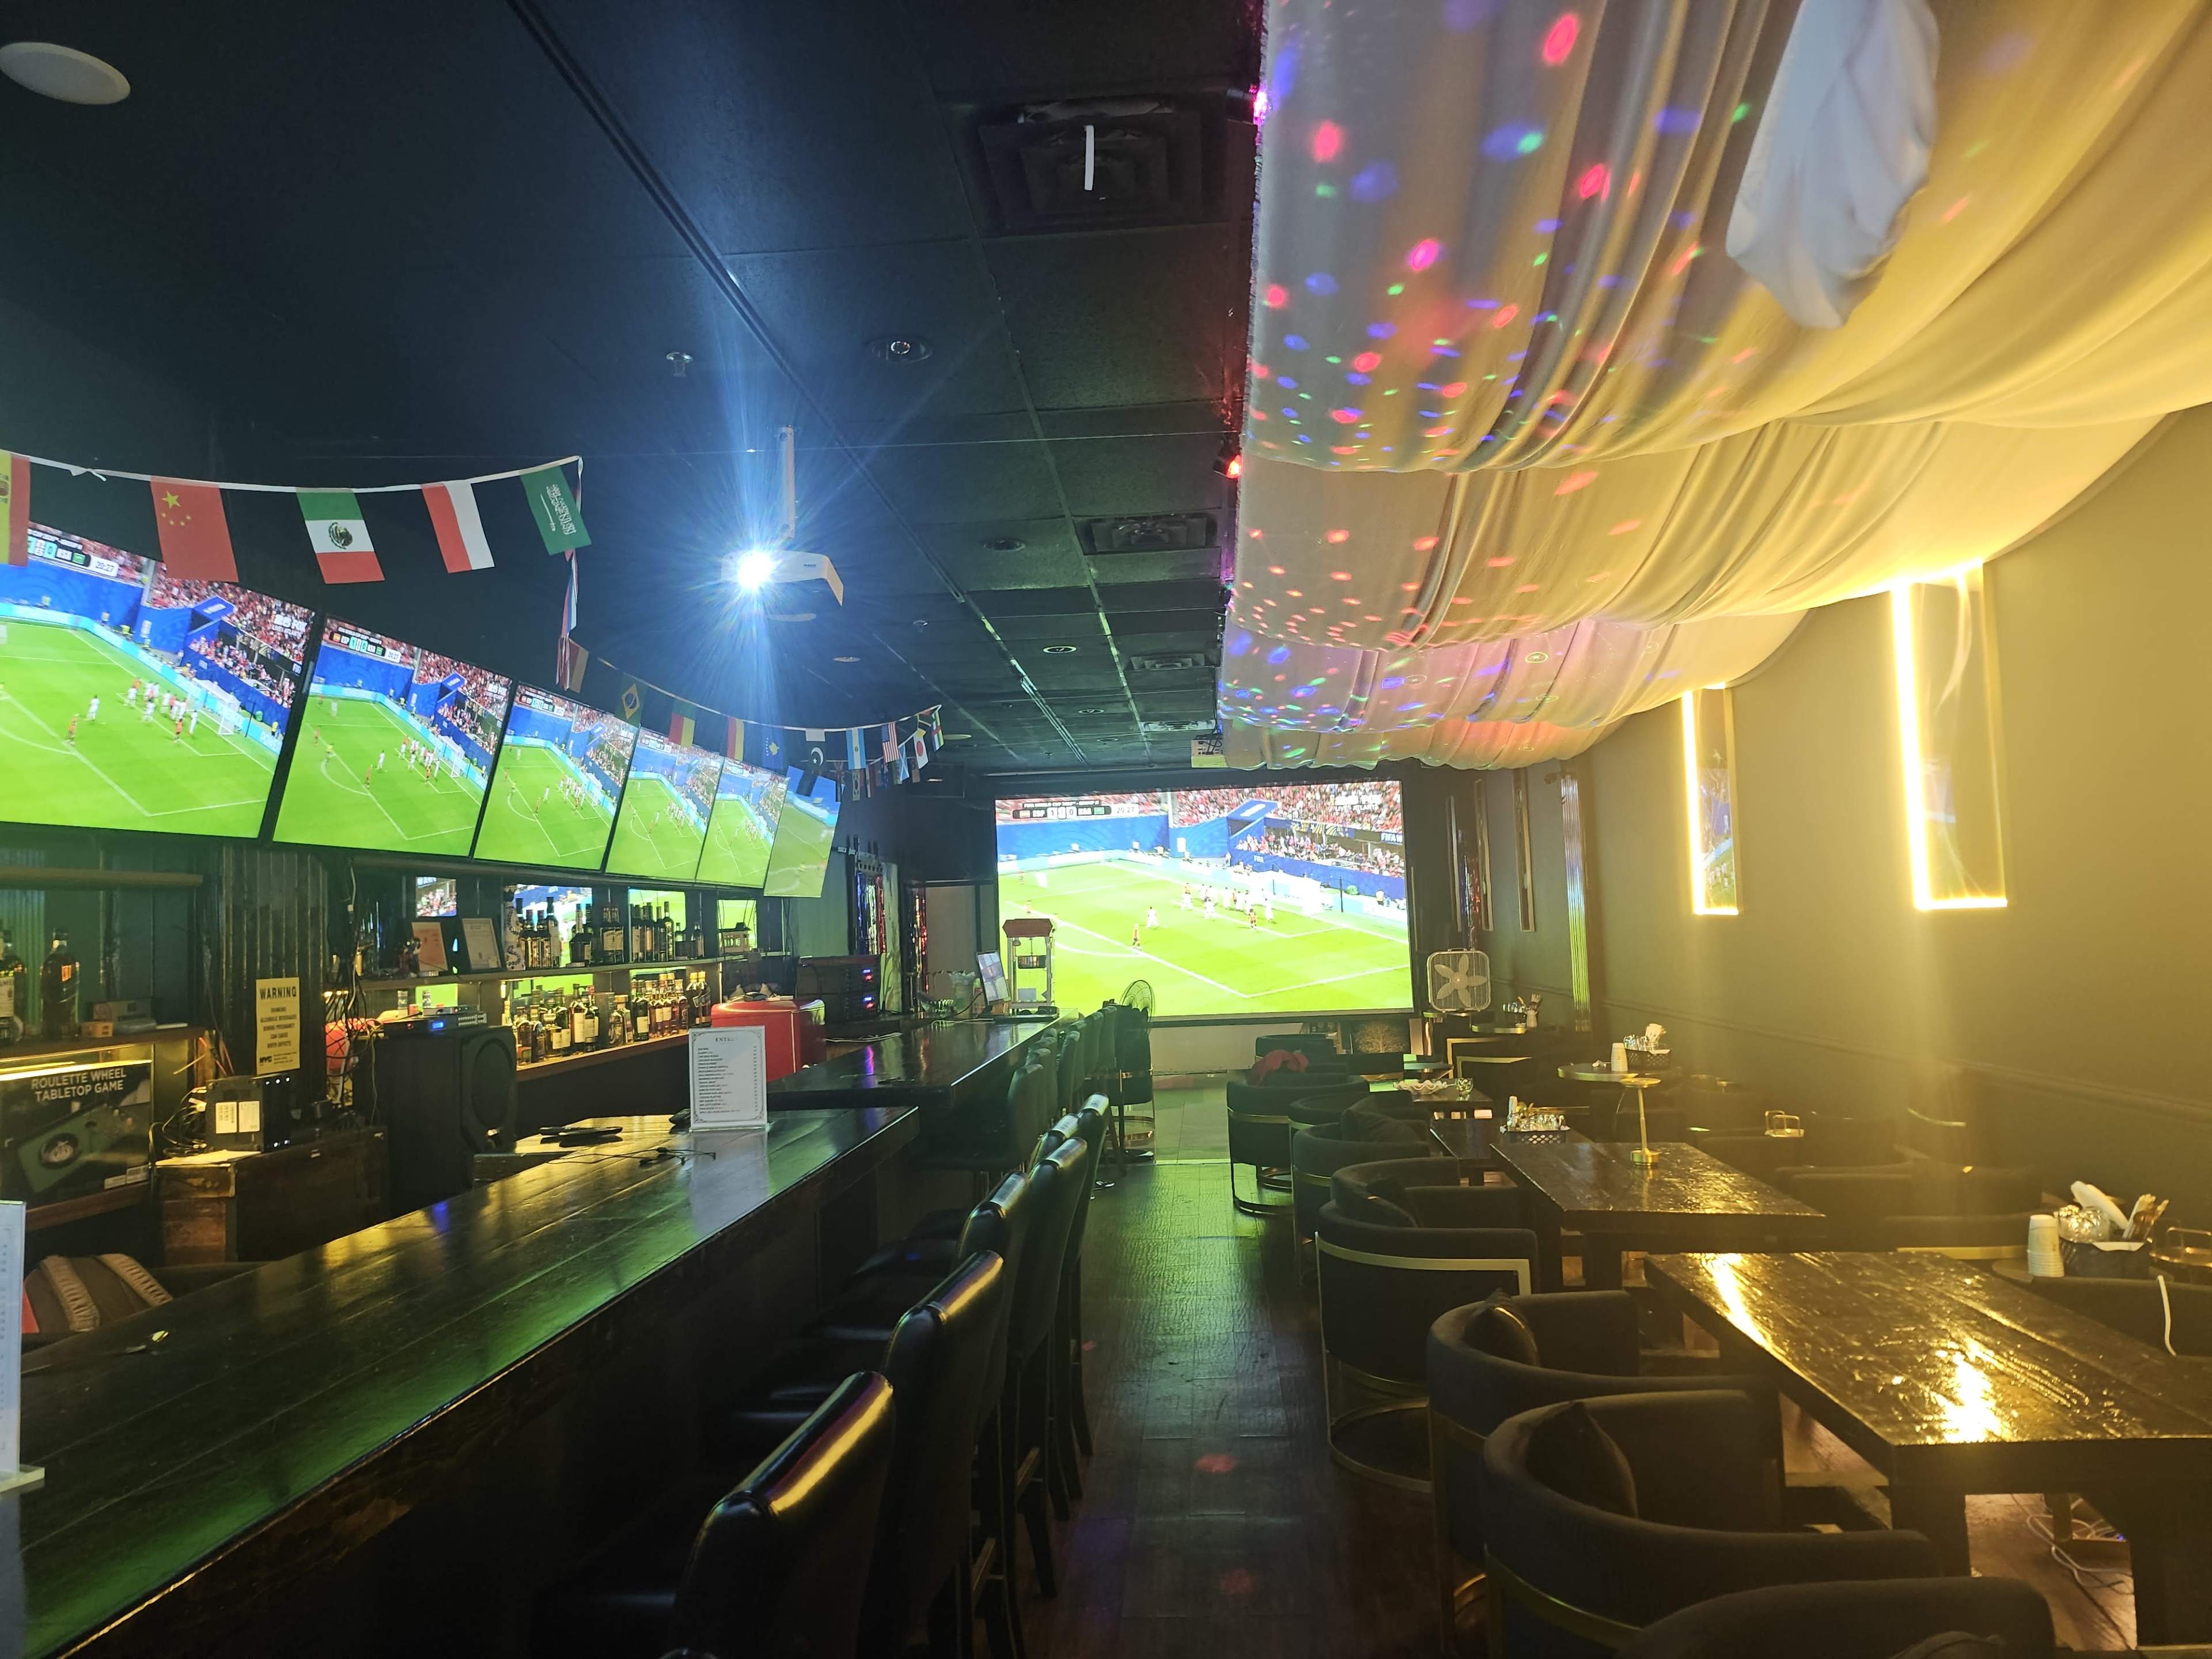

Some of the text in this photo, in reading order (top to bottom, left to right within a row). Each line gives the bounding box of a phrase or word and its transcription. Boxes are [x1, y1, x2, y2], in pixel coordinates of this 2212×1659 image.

[259, 986, 297, 1000] WARNING
[31, 1067, 127, 1089] ROULETTE WHEEL
[35, 1080, 124, 1102] TABLETOP GAME
